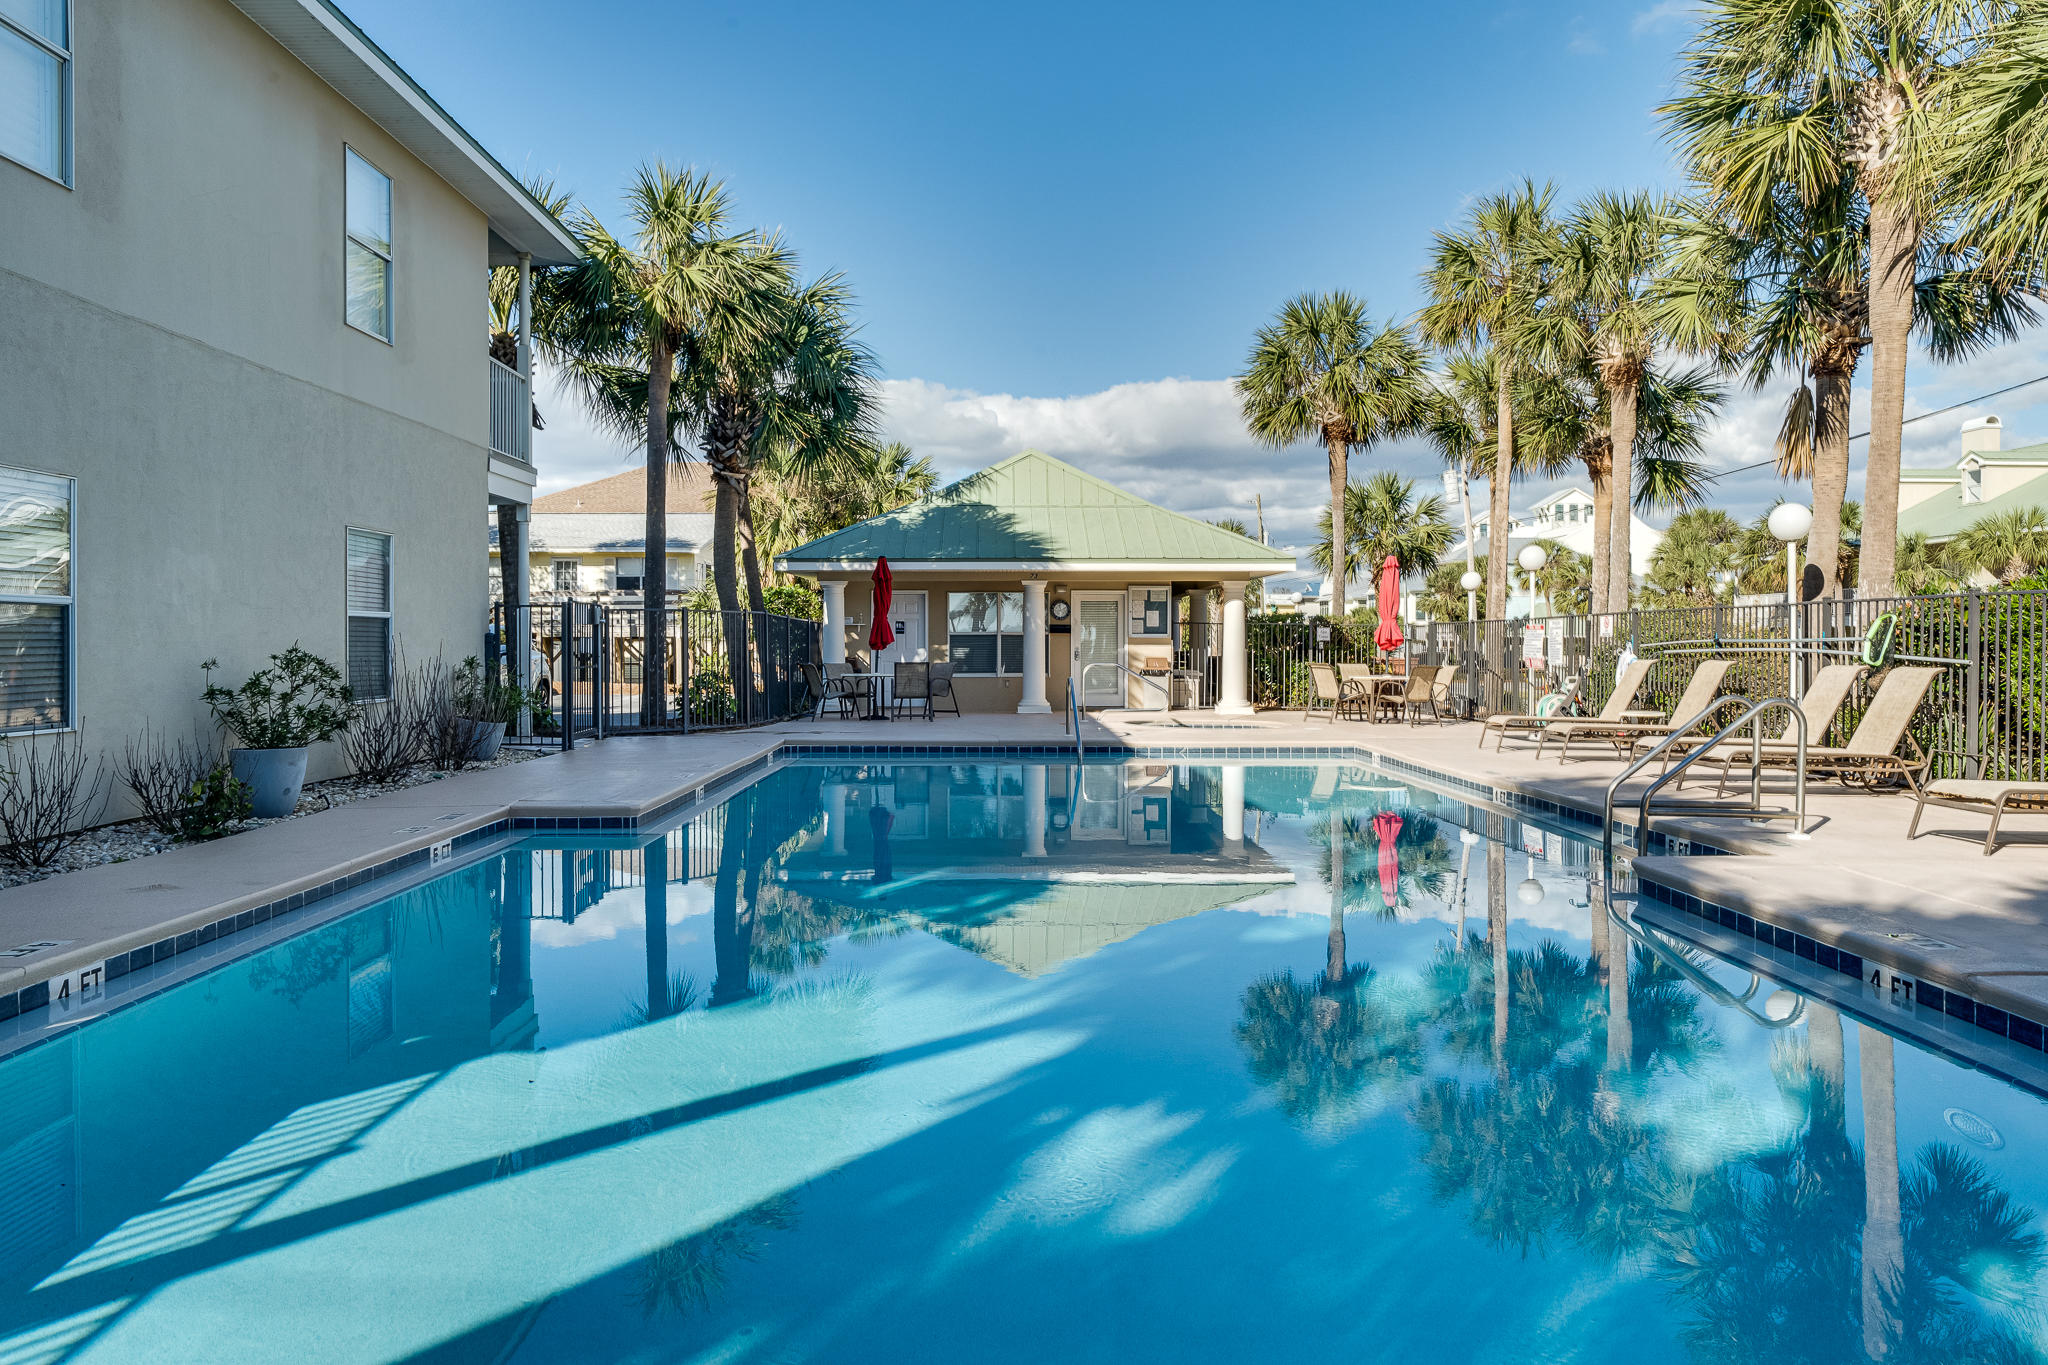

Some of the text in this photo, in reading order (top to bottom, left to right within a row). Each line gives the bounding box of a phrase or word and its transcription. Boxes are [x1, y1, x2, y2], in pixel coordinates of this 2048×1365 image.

[1678, 841, 1689, 856] FT
[57, 967, 102, 1000] 4 FT
[1870, 969, 1913, 1000] 4 FT
